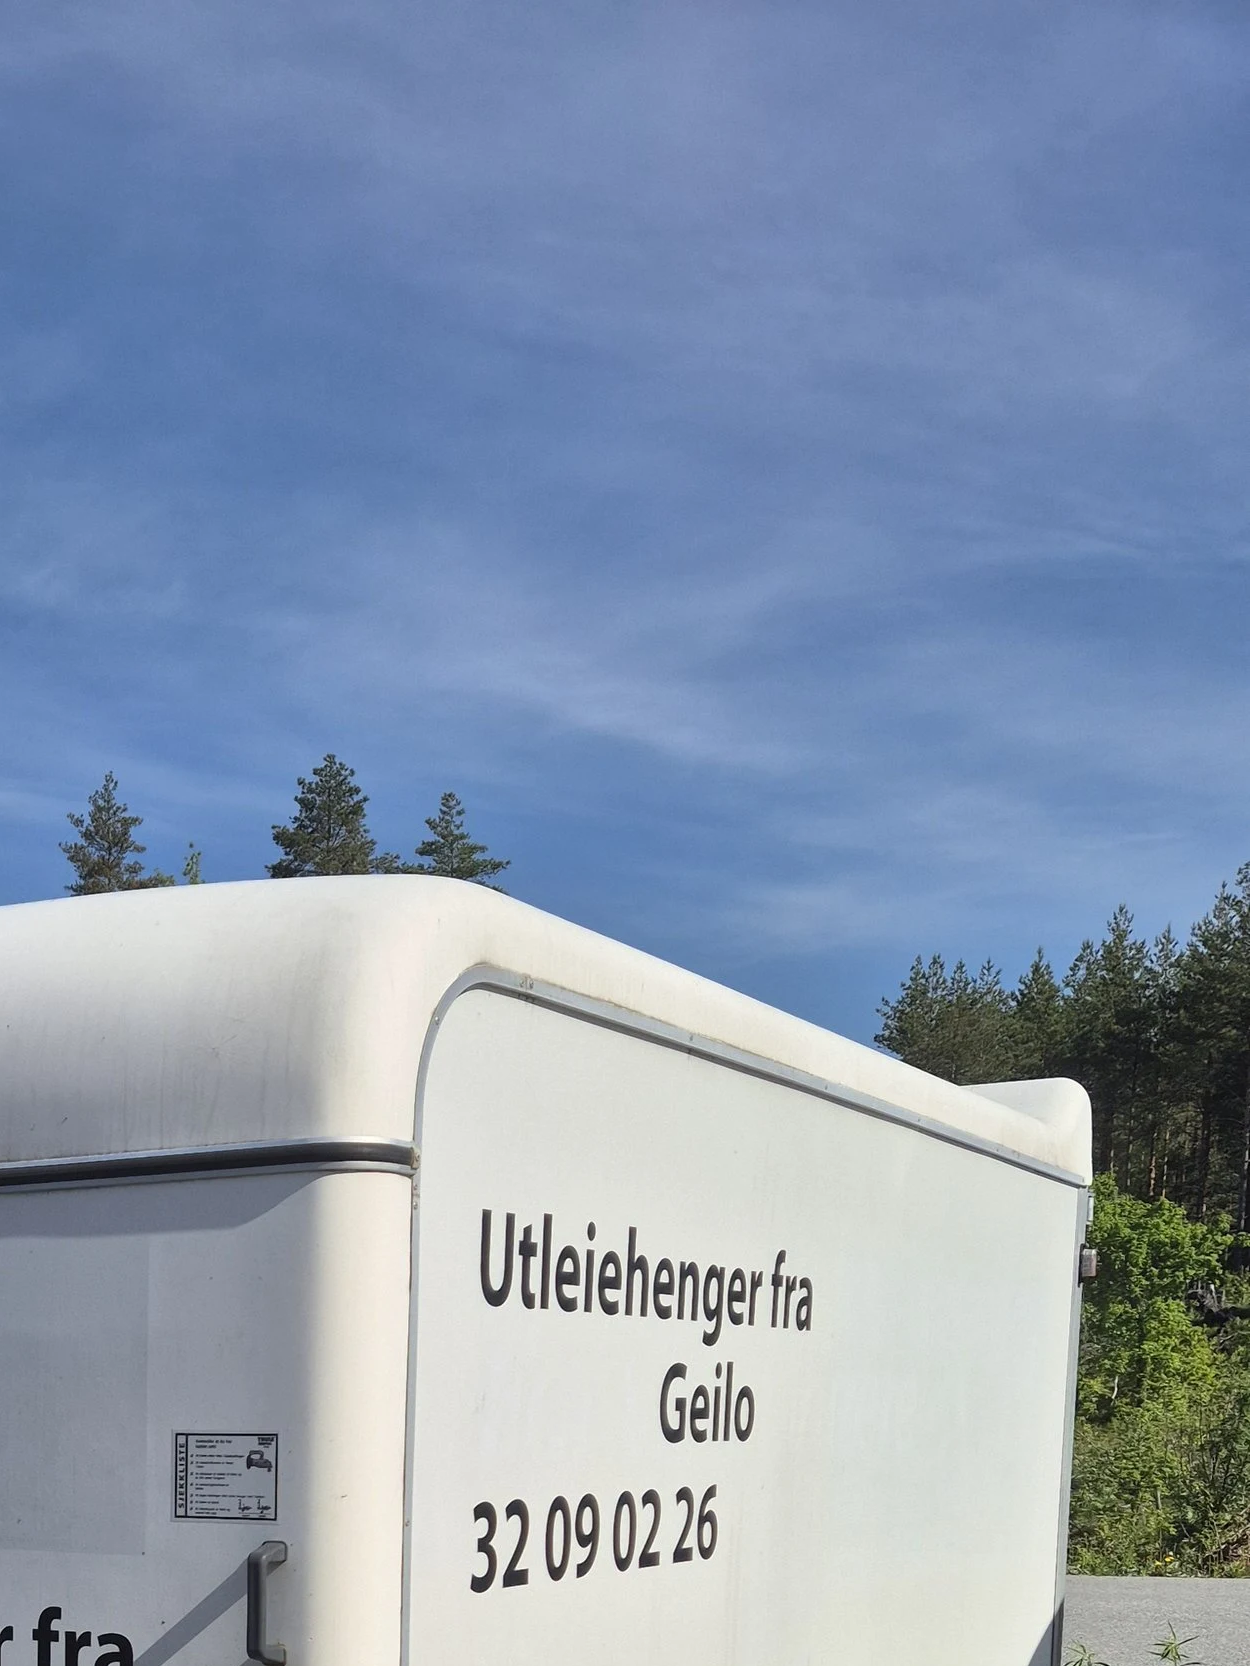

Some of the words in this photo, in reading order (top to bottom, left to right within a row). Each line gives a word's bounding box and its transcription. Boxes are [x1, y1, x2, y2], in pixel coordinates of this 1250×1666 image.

[480, 1208, 763, 1347] Utleiehenger
[771, 1249, 813, 1331] fra
[659, 1361, 755, 1444] Geilo
[178, 1442, 186, 1509] SJEKKLISTE
[470, 1499, 529, 1594] 32
[545, 1493, 600, 1582] 09
[612, 1489, 661, 1572] 02
[672, 1484, 718, 1564] 26
